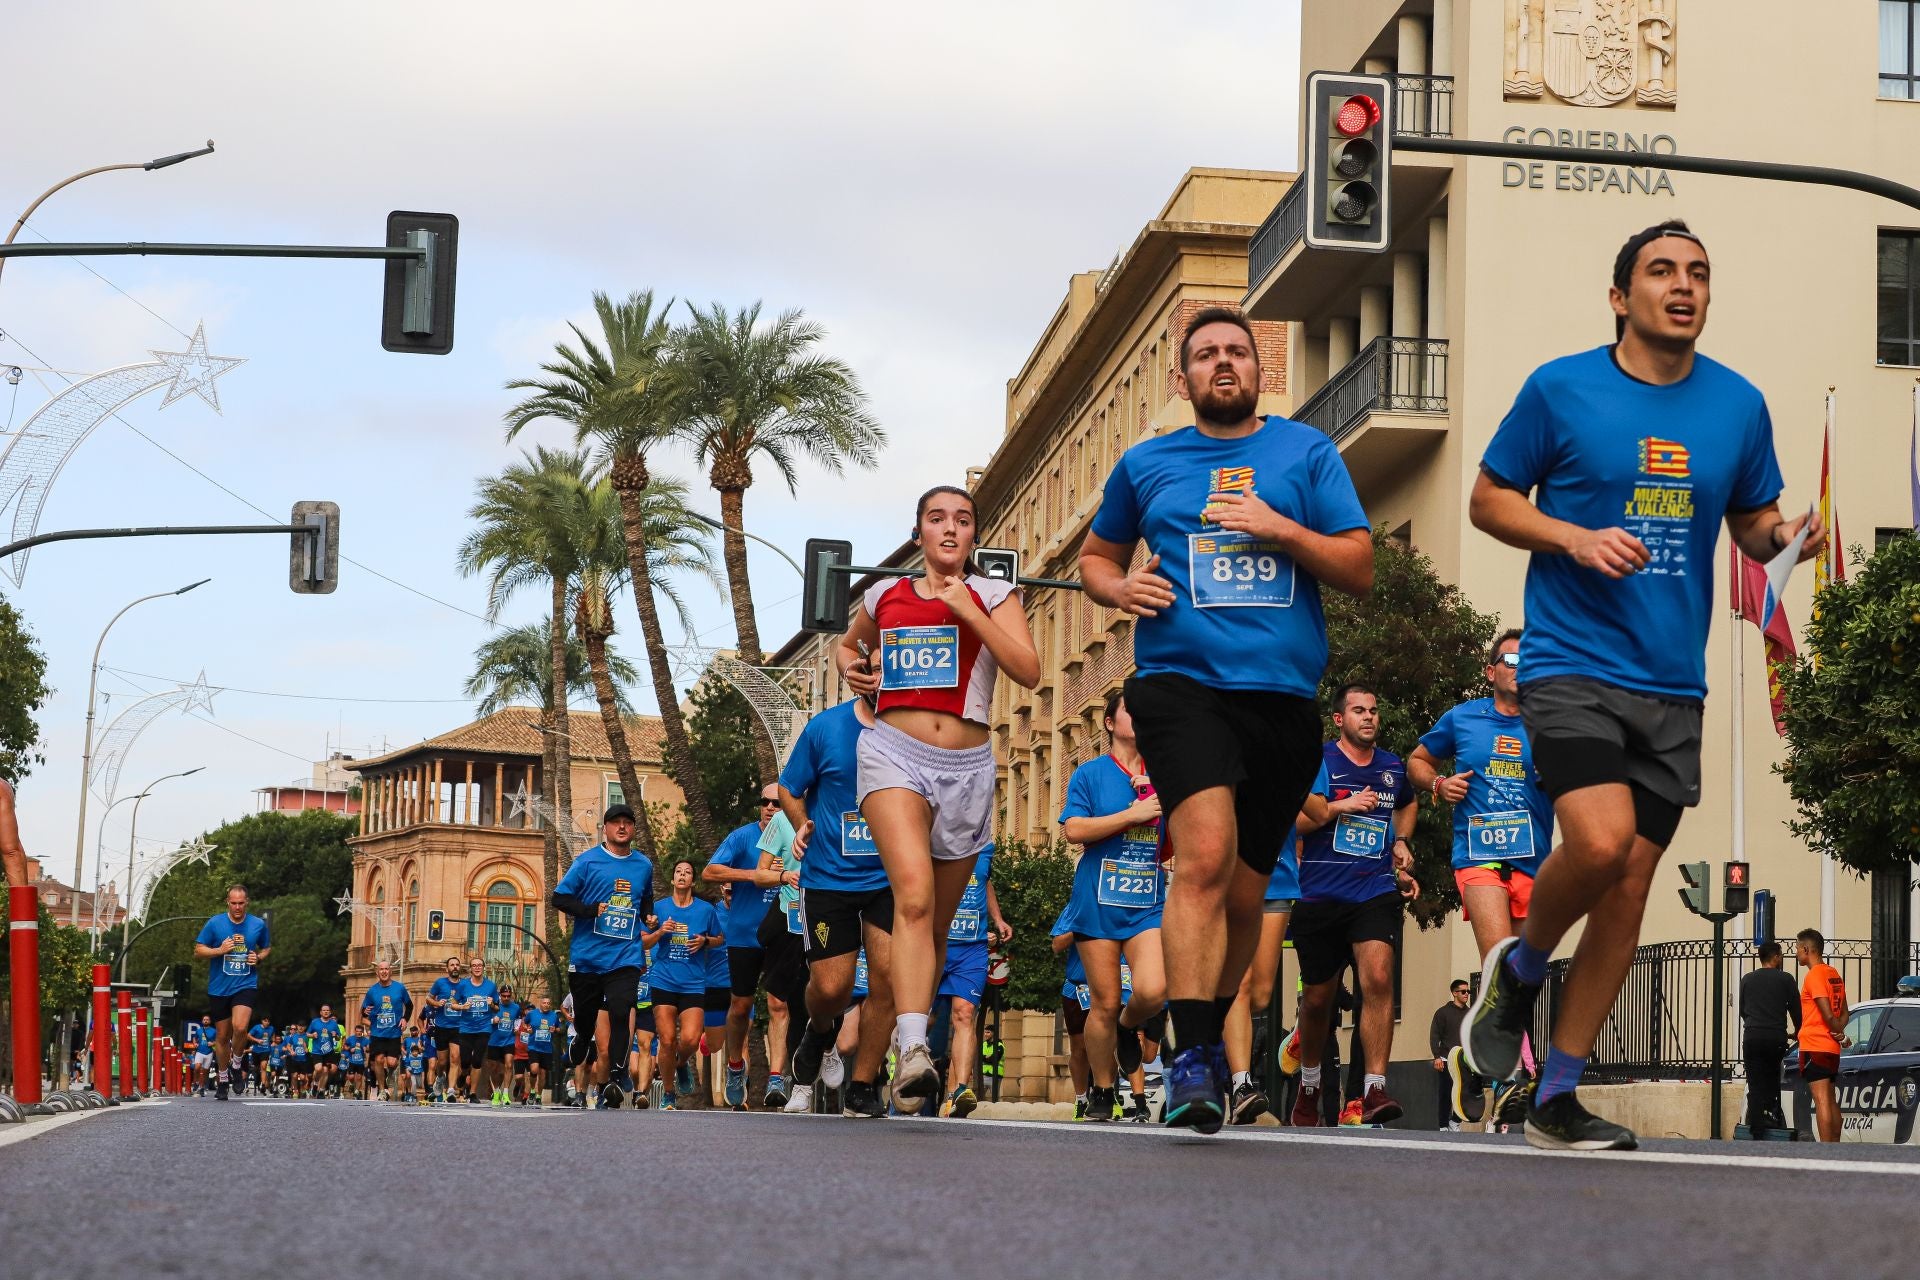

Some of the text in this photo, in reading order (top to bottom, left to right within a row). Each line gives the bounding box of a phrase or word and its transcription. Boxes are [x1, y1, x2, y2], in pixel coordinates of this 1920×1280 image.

[1502, 126, 1677, 155] GOBIERNO
[1502, 161, 1544, 188] DE
[1624, 501, 1694, 518] X VALENCIA
[1212, 556, 1277, 582] 839
[888, 647, 951, 669] 1062
[1484, 767, 1491, 775] X
[1491, 768, 1526, 778] VALENCIA
[1345, 828, 1377, 846] 516
[1481, 827, 1520, 845] 087
[1106, 875, 1154, 894] 1223
[604, 915, 628, 929] 128
[229, 961, 246, 970] 781
[187, 1023, 201, 1042] P
[1841, 1117, 1874, 1130] URCÍA
